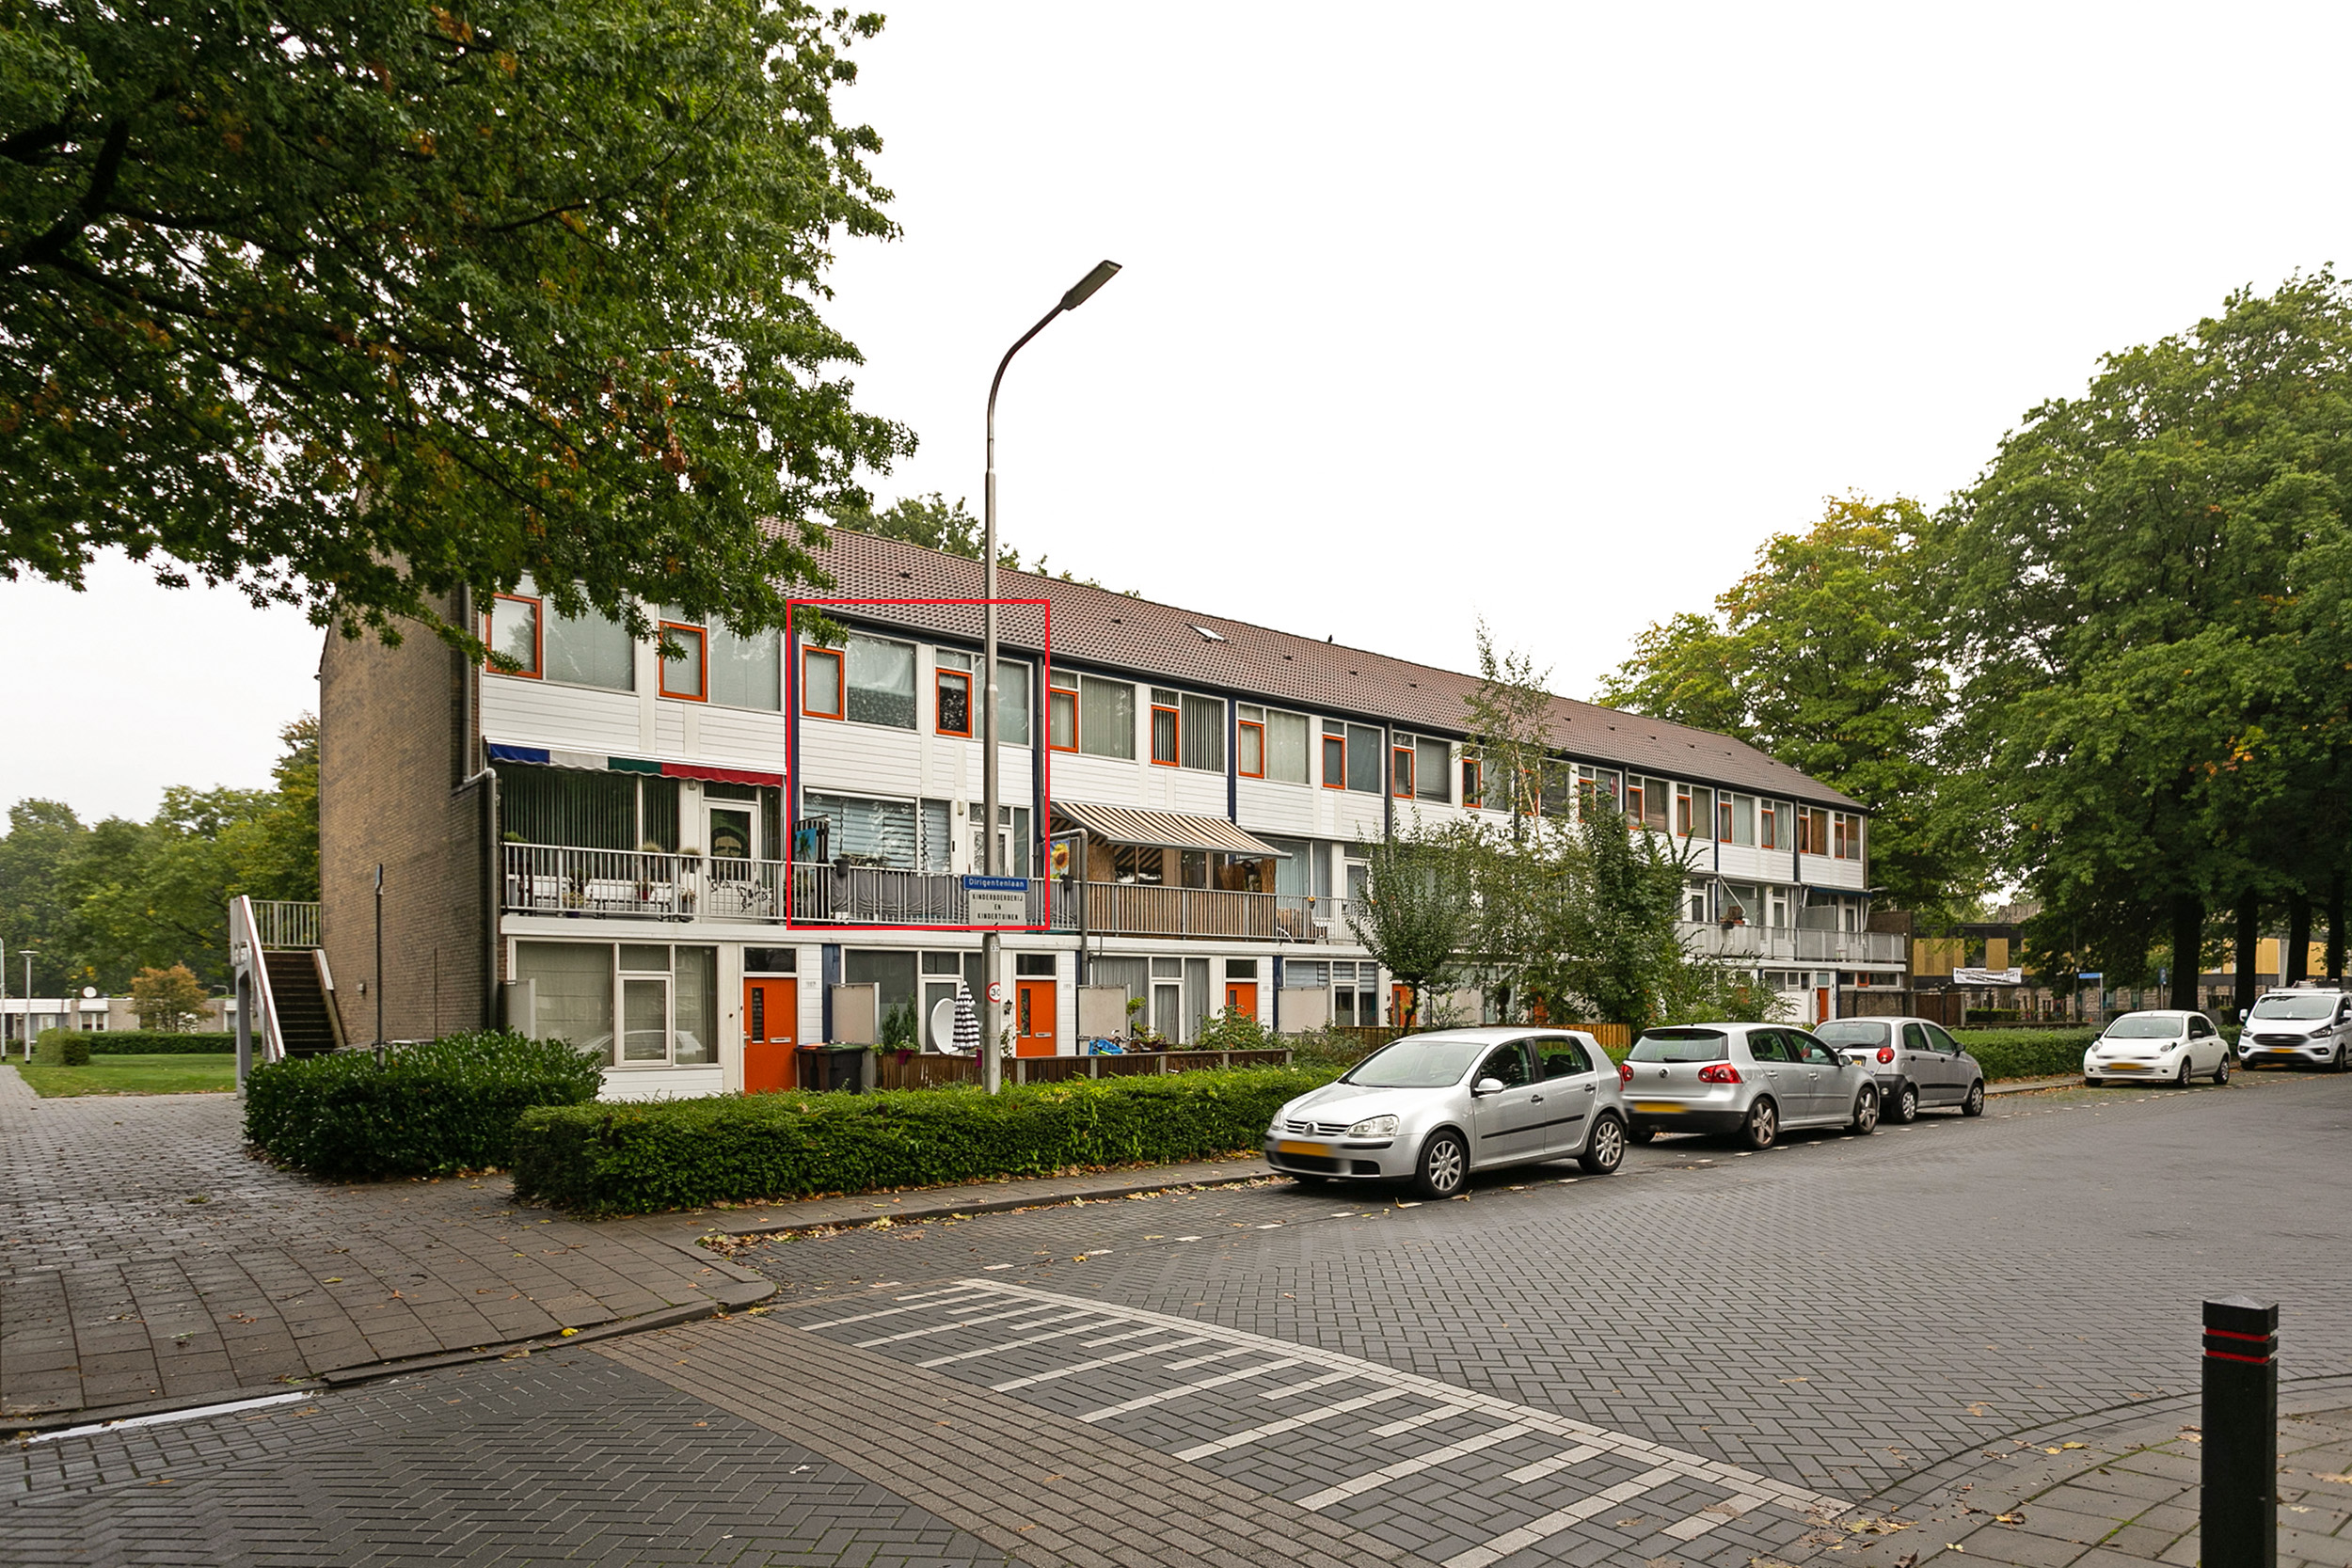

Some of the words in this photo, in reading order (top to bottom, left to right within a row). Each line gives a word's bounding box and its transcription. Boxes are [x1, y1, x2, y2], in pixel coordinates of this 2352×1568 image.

[968, 878, 1025, 888] Dirigentenlaan
[972, 894, 1023, 902] KINDERBOERDERIJ
[977, 912, 1019, 921] KINDERTUINEN
[991, 988, 1000, 997] 30
